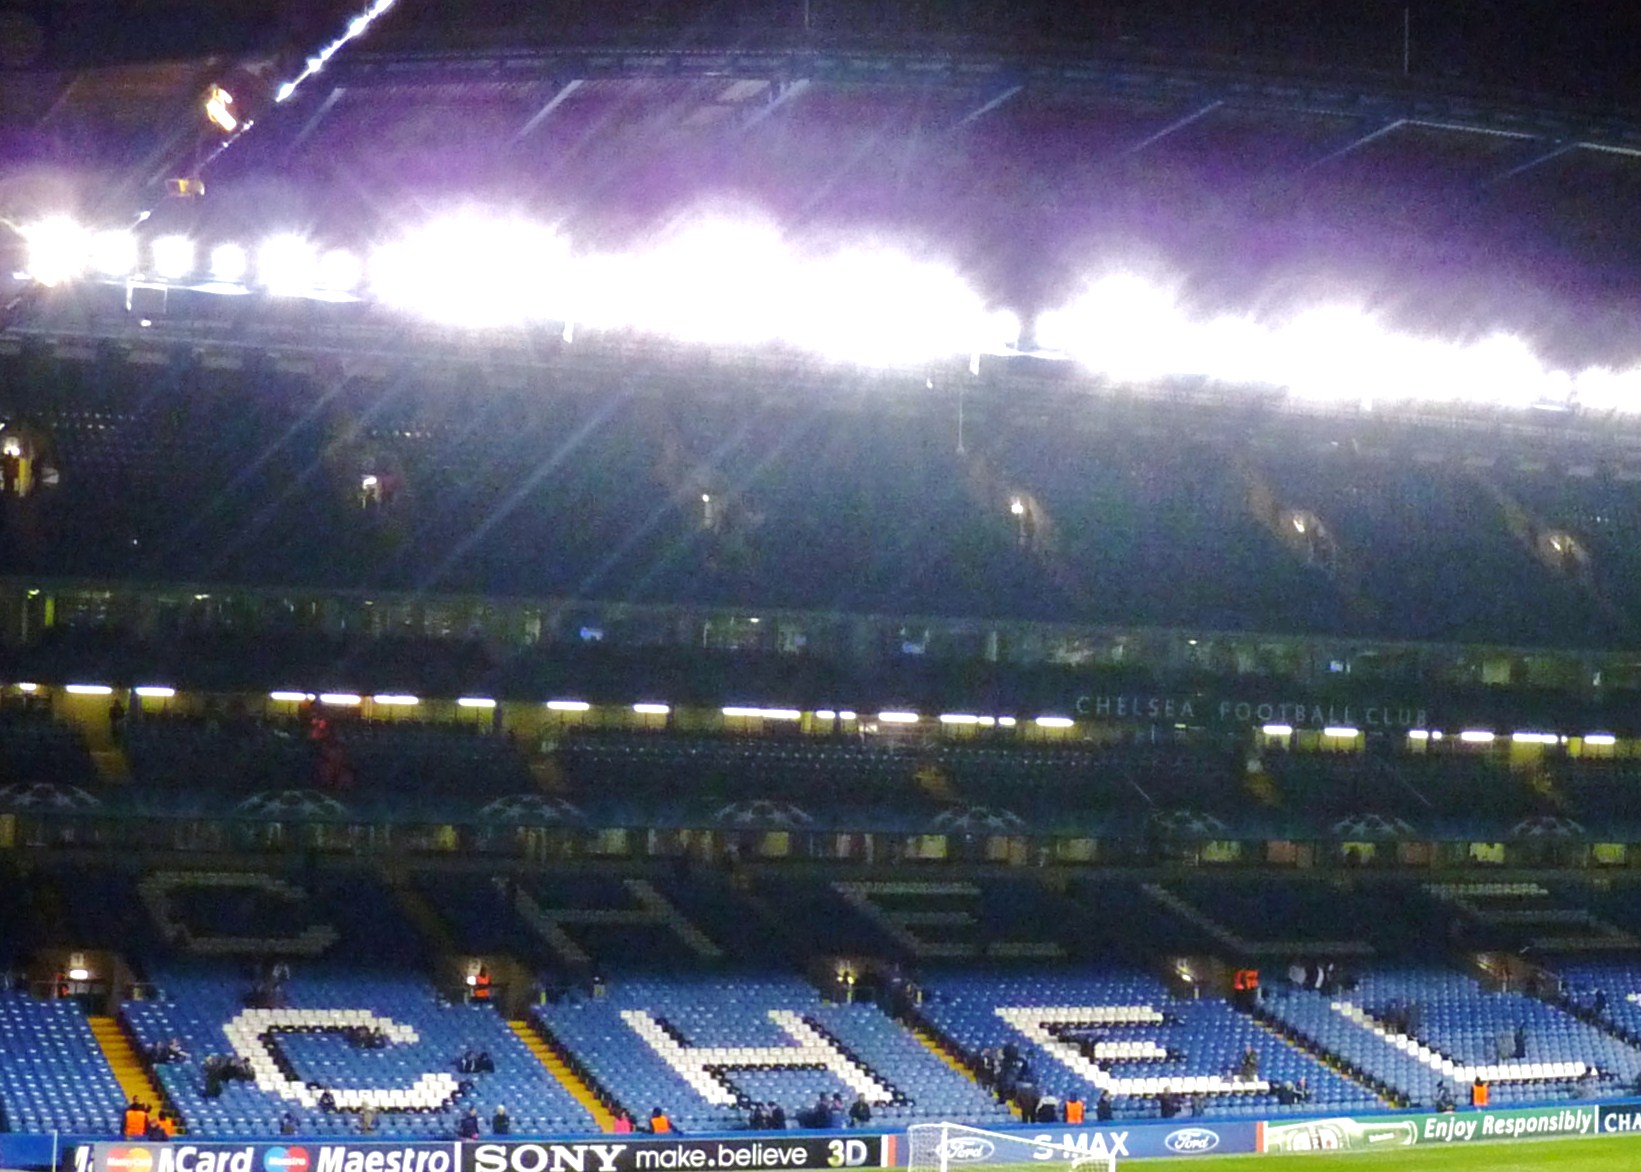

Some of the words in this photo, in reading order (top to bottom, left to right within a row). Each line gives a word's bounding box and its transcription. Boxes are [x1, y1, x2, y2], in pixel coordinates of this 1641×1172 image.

[1076, 697, 1194, 718] CHELSEA
[1220, 702, 1352, 723] FOOTBALL
[1366, 707, 1427, 728] CLUB
[1424, 1117, 1477, 1141] Enjoy
[1482, 1109, 1592, 1139] Responsibly
[827, 1139, 867, 1168] 3D
